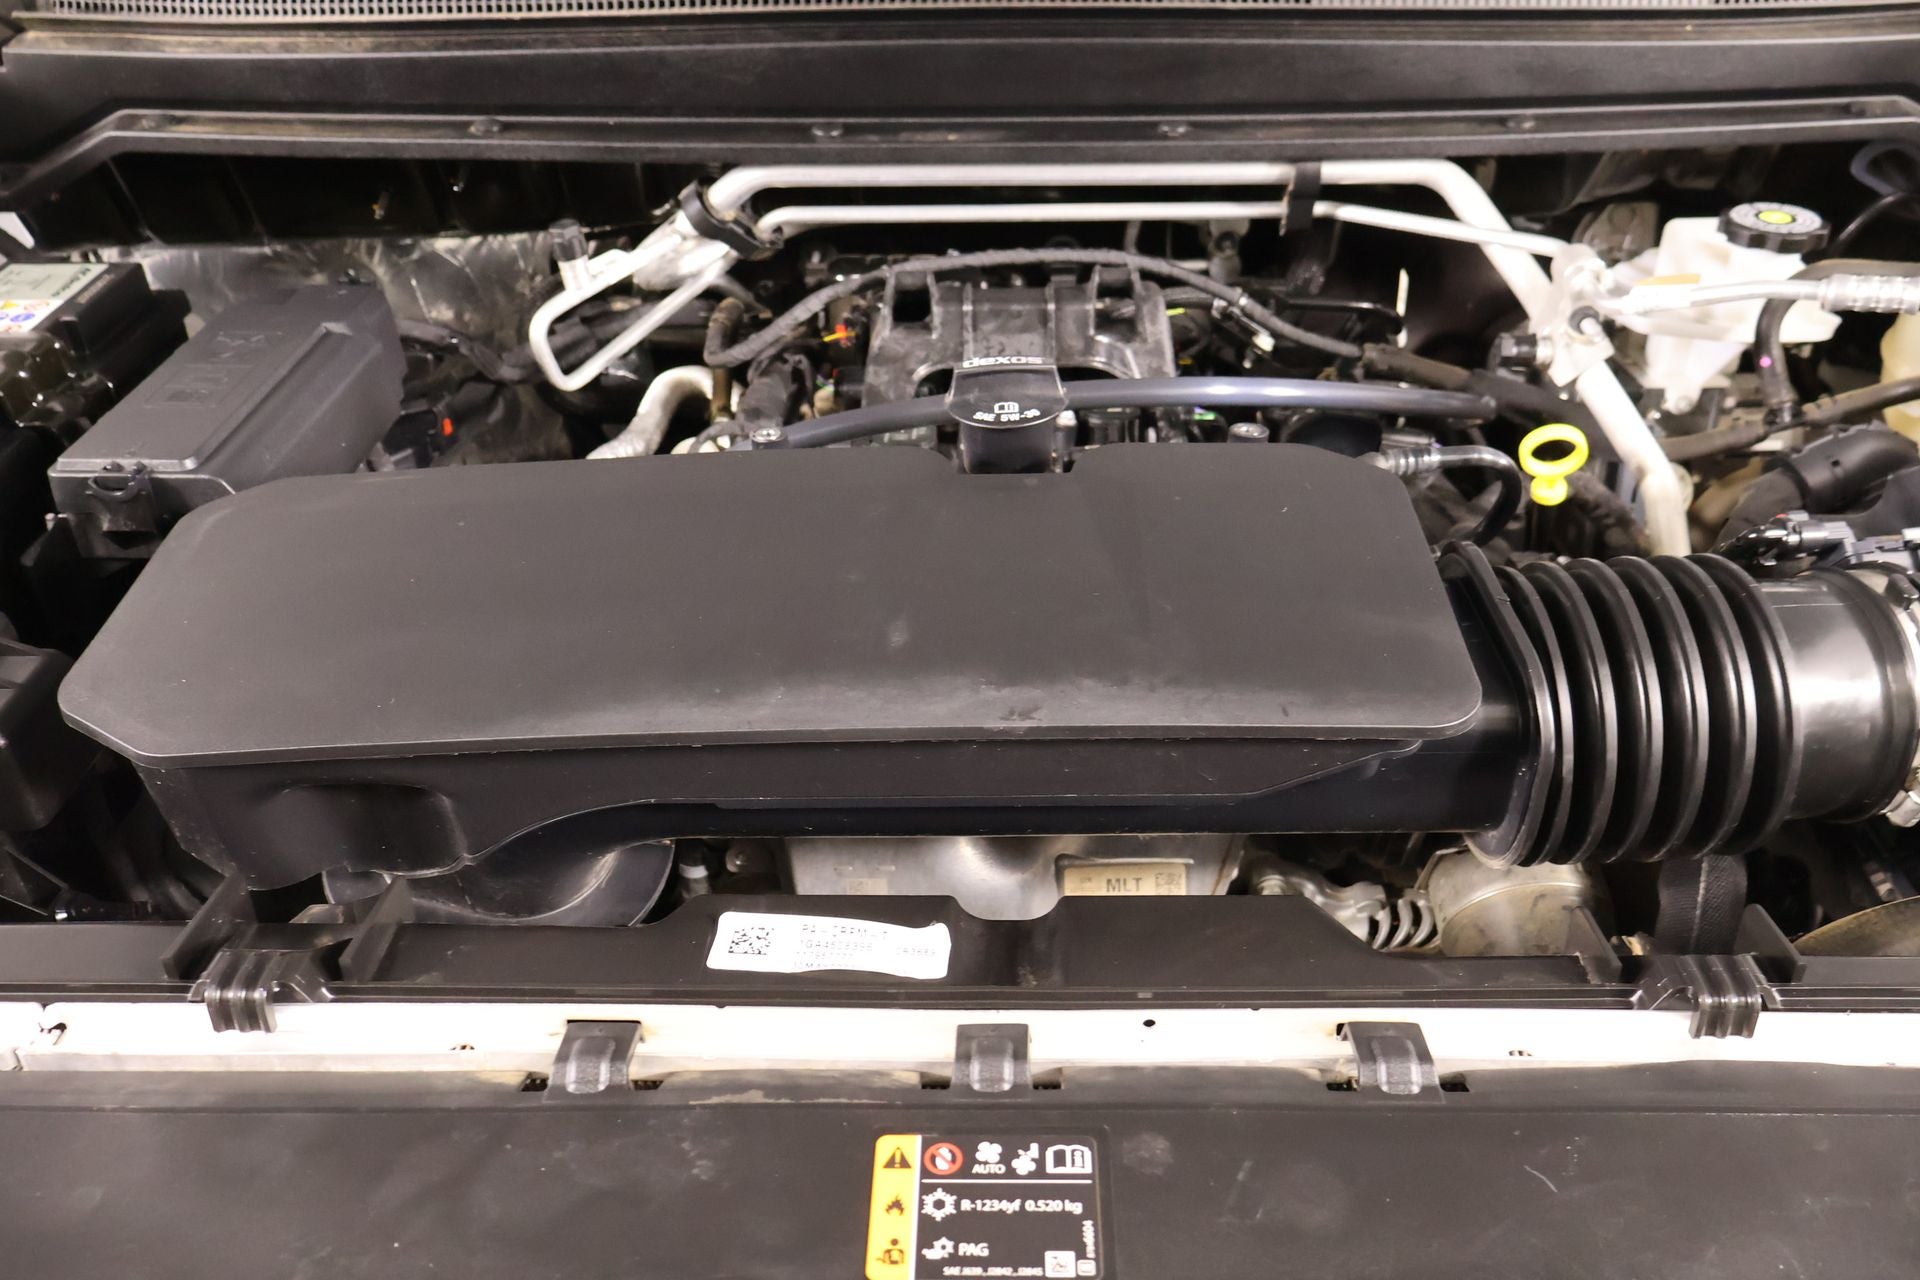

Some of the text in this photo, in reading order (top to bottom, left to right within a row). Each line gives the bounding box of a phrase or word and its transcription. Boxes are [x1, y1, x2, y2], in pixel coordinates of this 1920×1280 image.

[962, 356, 1042, 368] dexos
[973, 411, 996, 421] SAE
[1105, 877, 1143, 893] MLT
[971, 1163, 1006, 1175] AUTO
[960, 1198, 1083, 1215] R-1234yf 0.520 kg
[957, 1242, 989, 1257] PAG
